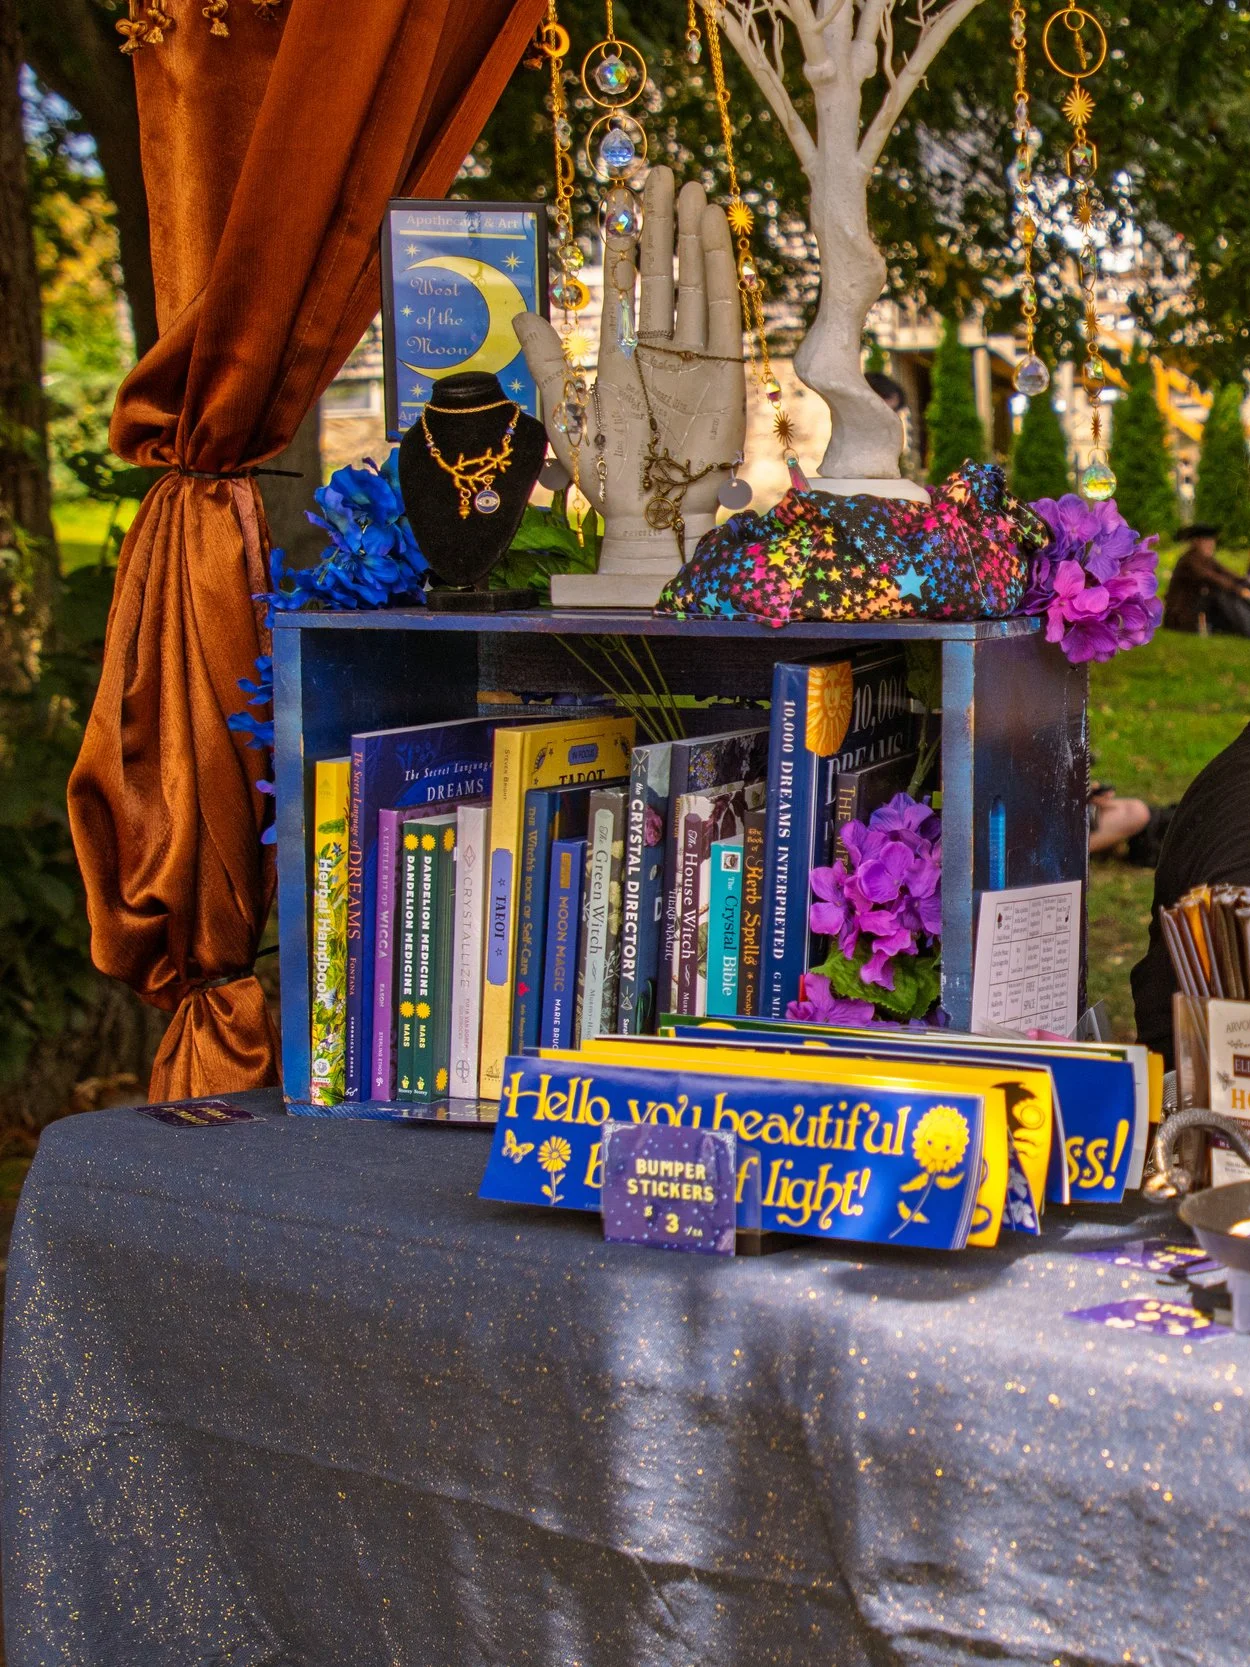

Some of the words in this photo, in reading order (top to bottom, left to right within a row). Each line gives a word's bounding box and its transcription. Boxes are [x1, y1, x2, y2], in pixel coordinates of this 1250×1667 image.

[406, 214, 481, 229] Apothecary
[498, 218, 519, 229] Art
[410, 277, 461, 297] West
[416, 308, 436, 331] of
[437, 309, 464, 326] the
[406, 336, 469, 356] Moon
[782, 699, 796, 753] 10,000
[352, 768, 363, 795] Secret
[353, 751, 363, 767] The
[405, 770, 420, 782] The
[424, 766, 450, 779] Secret
[427, 778, 485, 802] DREAMS
[635, 782, 644, 795] the
[777, 761, 794, 839] DREAMS
[838, 786, 856, 821] THE
[350, 799, 362, 839] Language
[599, 826, 609, 845] The
[627, 799, 644, 875] CRYSTAL
[688, 829, 698, 849] The
[526, 830, 538, 872] Witch's
[317, 858, 332, 916] Herbal
[348, 851, 363, 940] DREAMS
[405, 855, 415, 929] DANDELION
[421, 855, 432, 930] DANDELION
[593, 850, 608, 900] Green
[683, 852, 698, 906] House
[745, 856, 764, 905] Herb
[381, 894, 388, 908] OF
[493, 896, 507, 941] TAROT
[557, 896, 569, 942] MOON
[721, 895, 739, 951] Crystal
[772, 846, 789, 960] INTERPRETED
[378, 911, 389, 959] WICCA
[460, 876, 473, 989] CRYSTALLIZE
[520, 922, 533, 976] Self-Care
[589, 905, 605, 955] Witch
[622, 881, 640, 982] DIRECTORY
[664, 923, 675, 961] MAGIC
[681, 909, 697, 960] Witch
[741, 910, 761, 966] Spells
[349, 957, 357, 996] FONTANA
[403, 932, 414, 995] MEDICINE
[419, 933, 430, 996] MEDICINE
[553, 945, 567, 992] MAGIC
[721, 955, 737, 997] Bible
[773, 971, 782, 980] G
[772, 984, 781, 992] H
[553, 999, 562, 1025] MARIE
[715, 1092, 912, 1156] beautiful
[627, 1178, 715, 1203] STICKERS
[635, 1158, 706, 1181] BUMPER
[762, 1158, 872, 1230] light!
